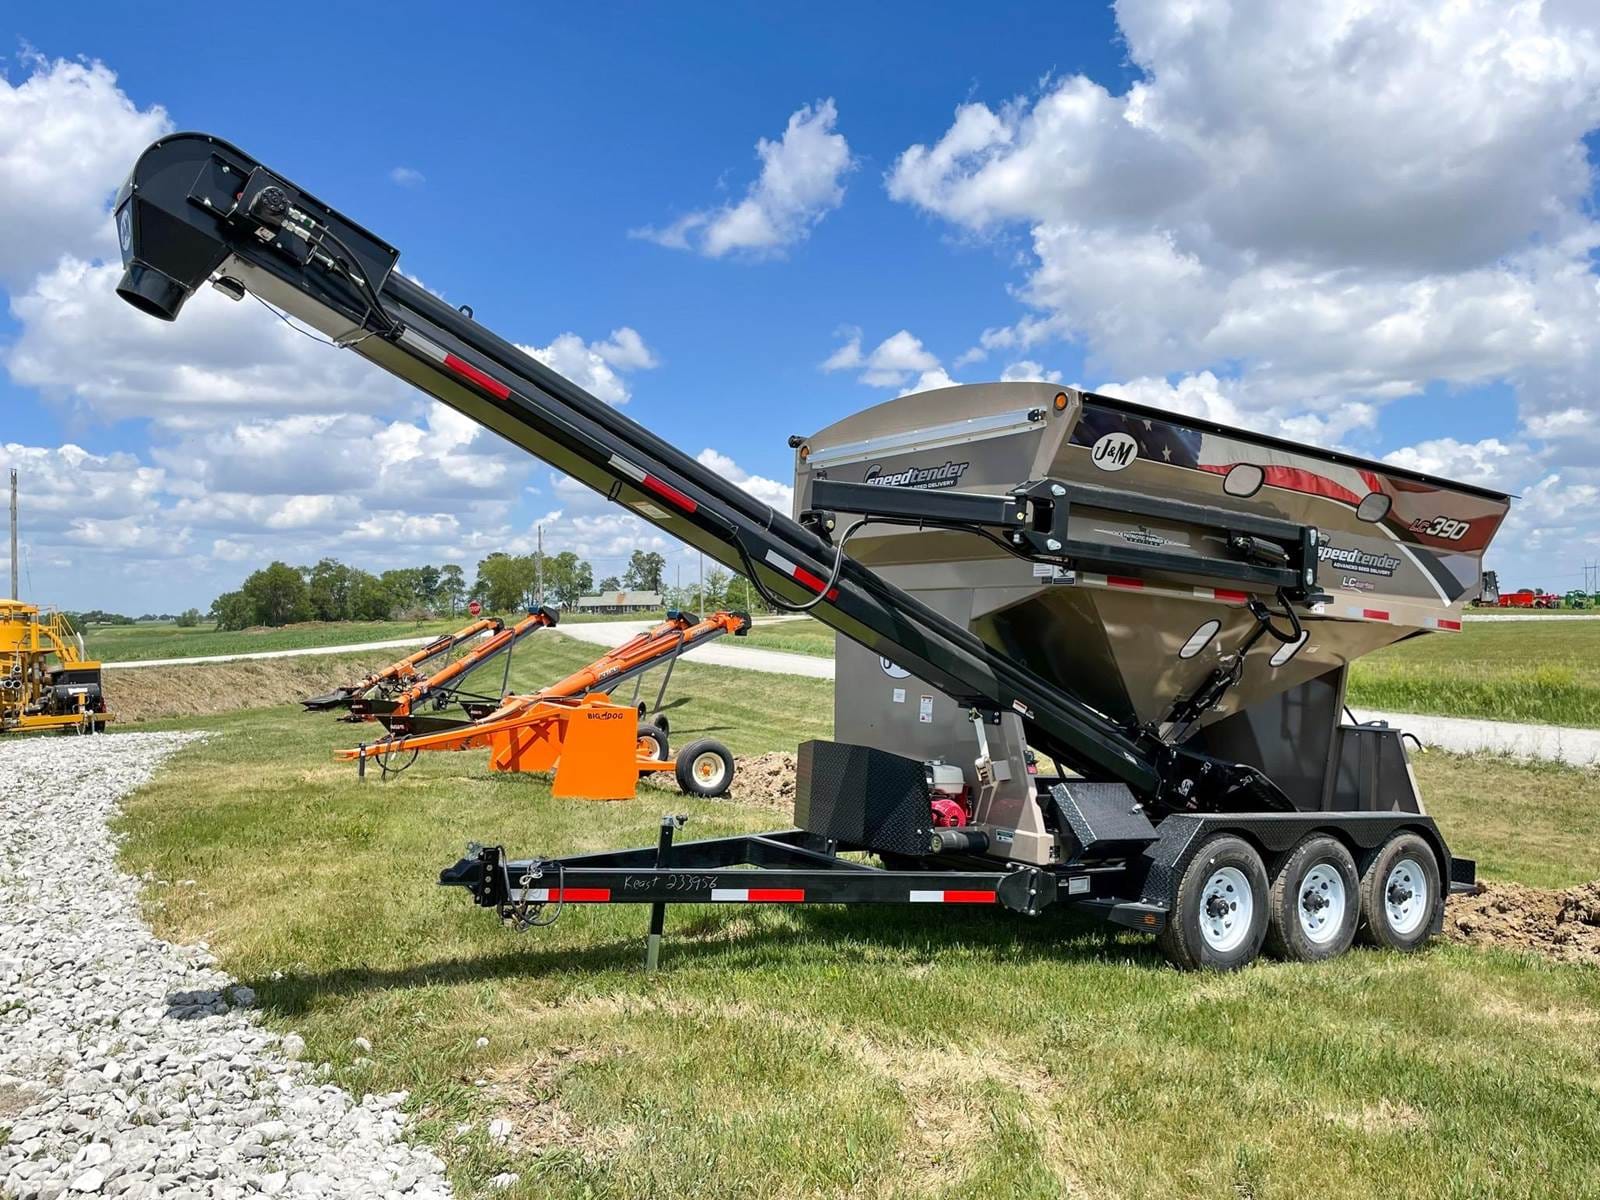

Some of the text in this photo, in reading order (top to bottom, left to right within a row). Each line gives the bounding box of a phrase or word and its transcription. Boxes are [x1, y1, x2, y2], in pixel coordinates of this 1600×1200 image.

[1094, 439, 1134, 465] J&M
[587, 712, 624, 721] BIG DOG
[666, 874, 718, 891] 233956
